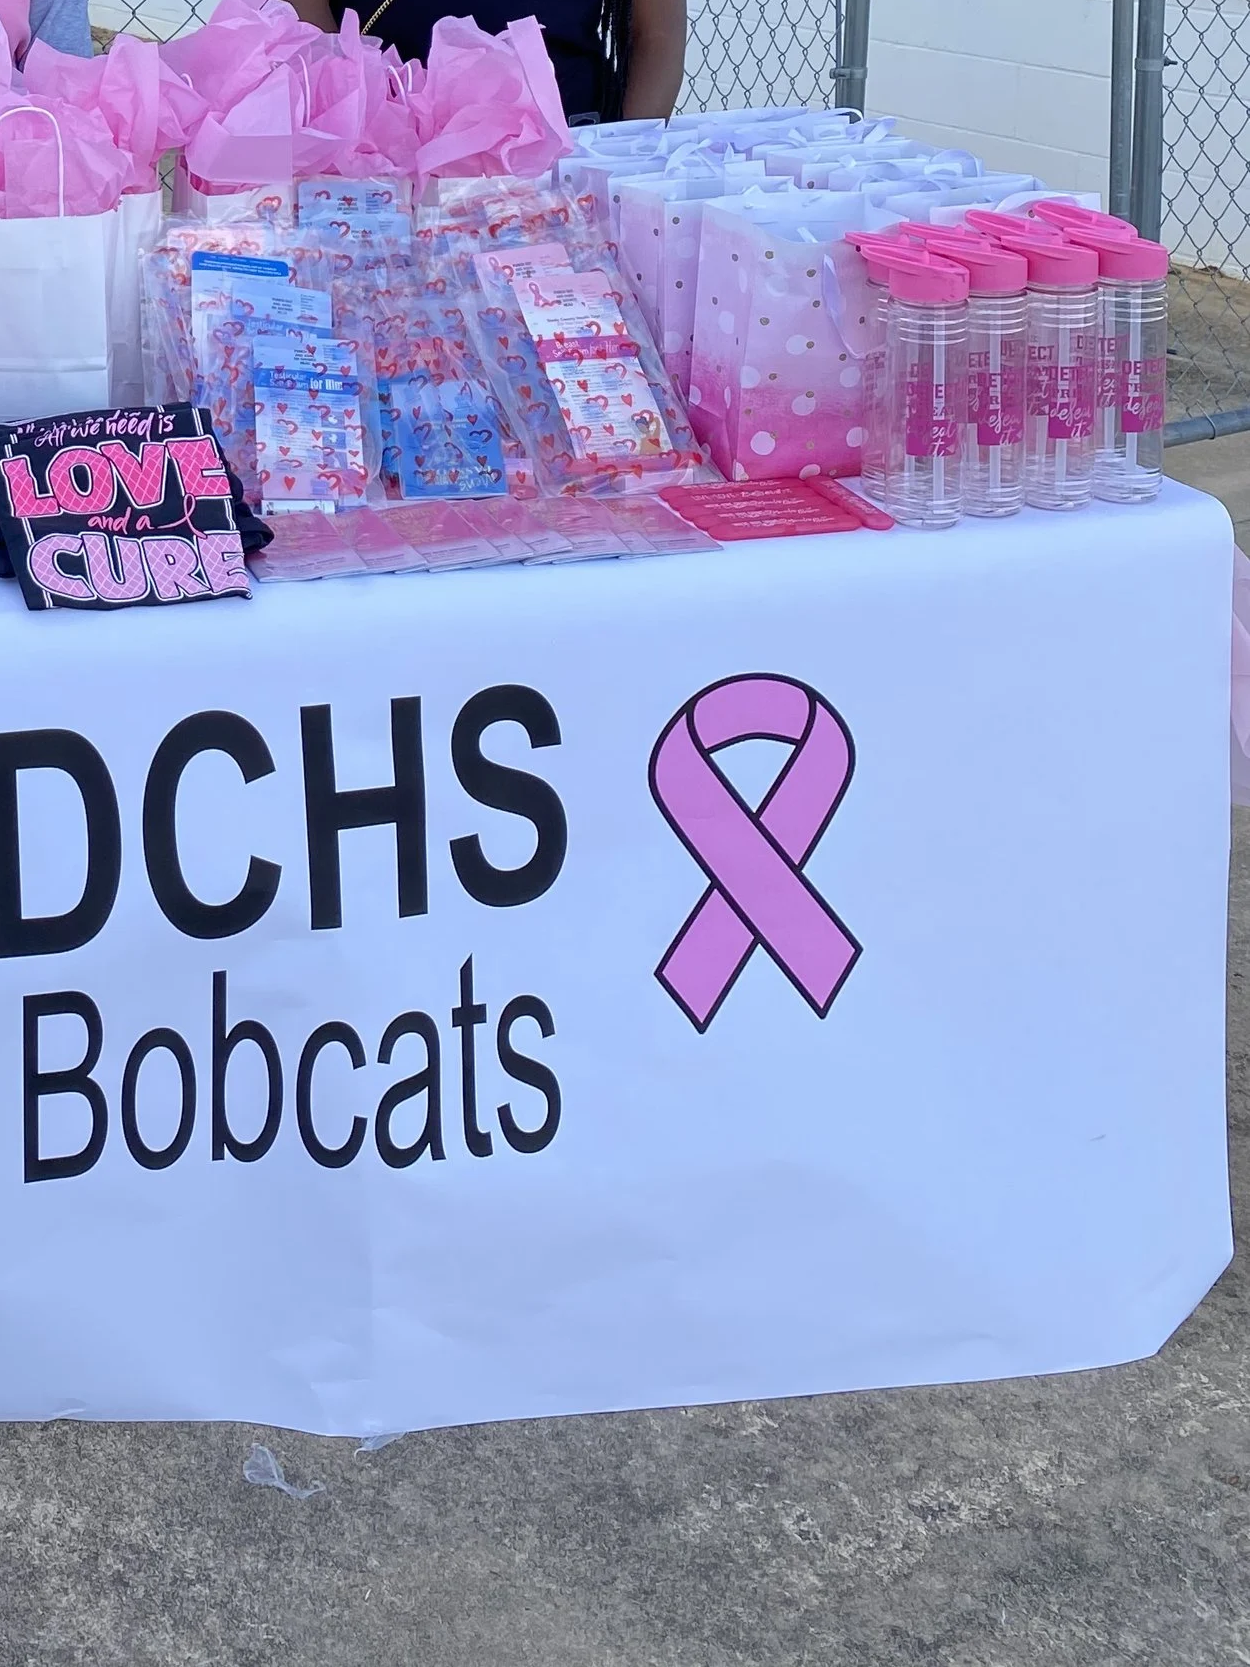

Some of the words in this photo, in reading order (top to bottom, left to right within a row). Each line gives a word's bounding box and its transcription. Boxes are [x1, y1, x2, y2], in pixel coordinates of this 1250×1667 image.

[106, 410, 154, 442] need
[158, 414, 176, 435] is
[0, 434, 234, 519] LOVE
[88, 506, 132, 534] and
[136, 518, 156, 530] a
[27, 530, 254, 603] CURE
[22, 952, 562, 1184] Bobcats
